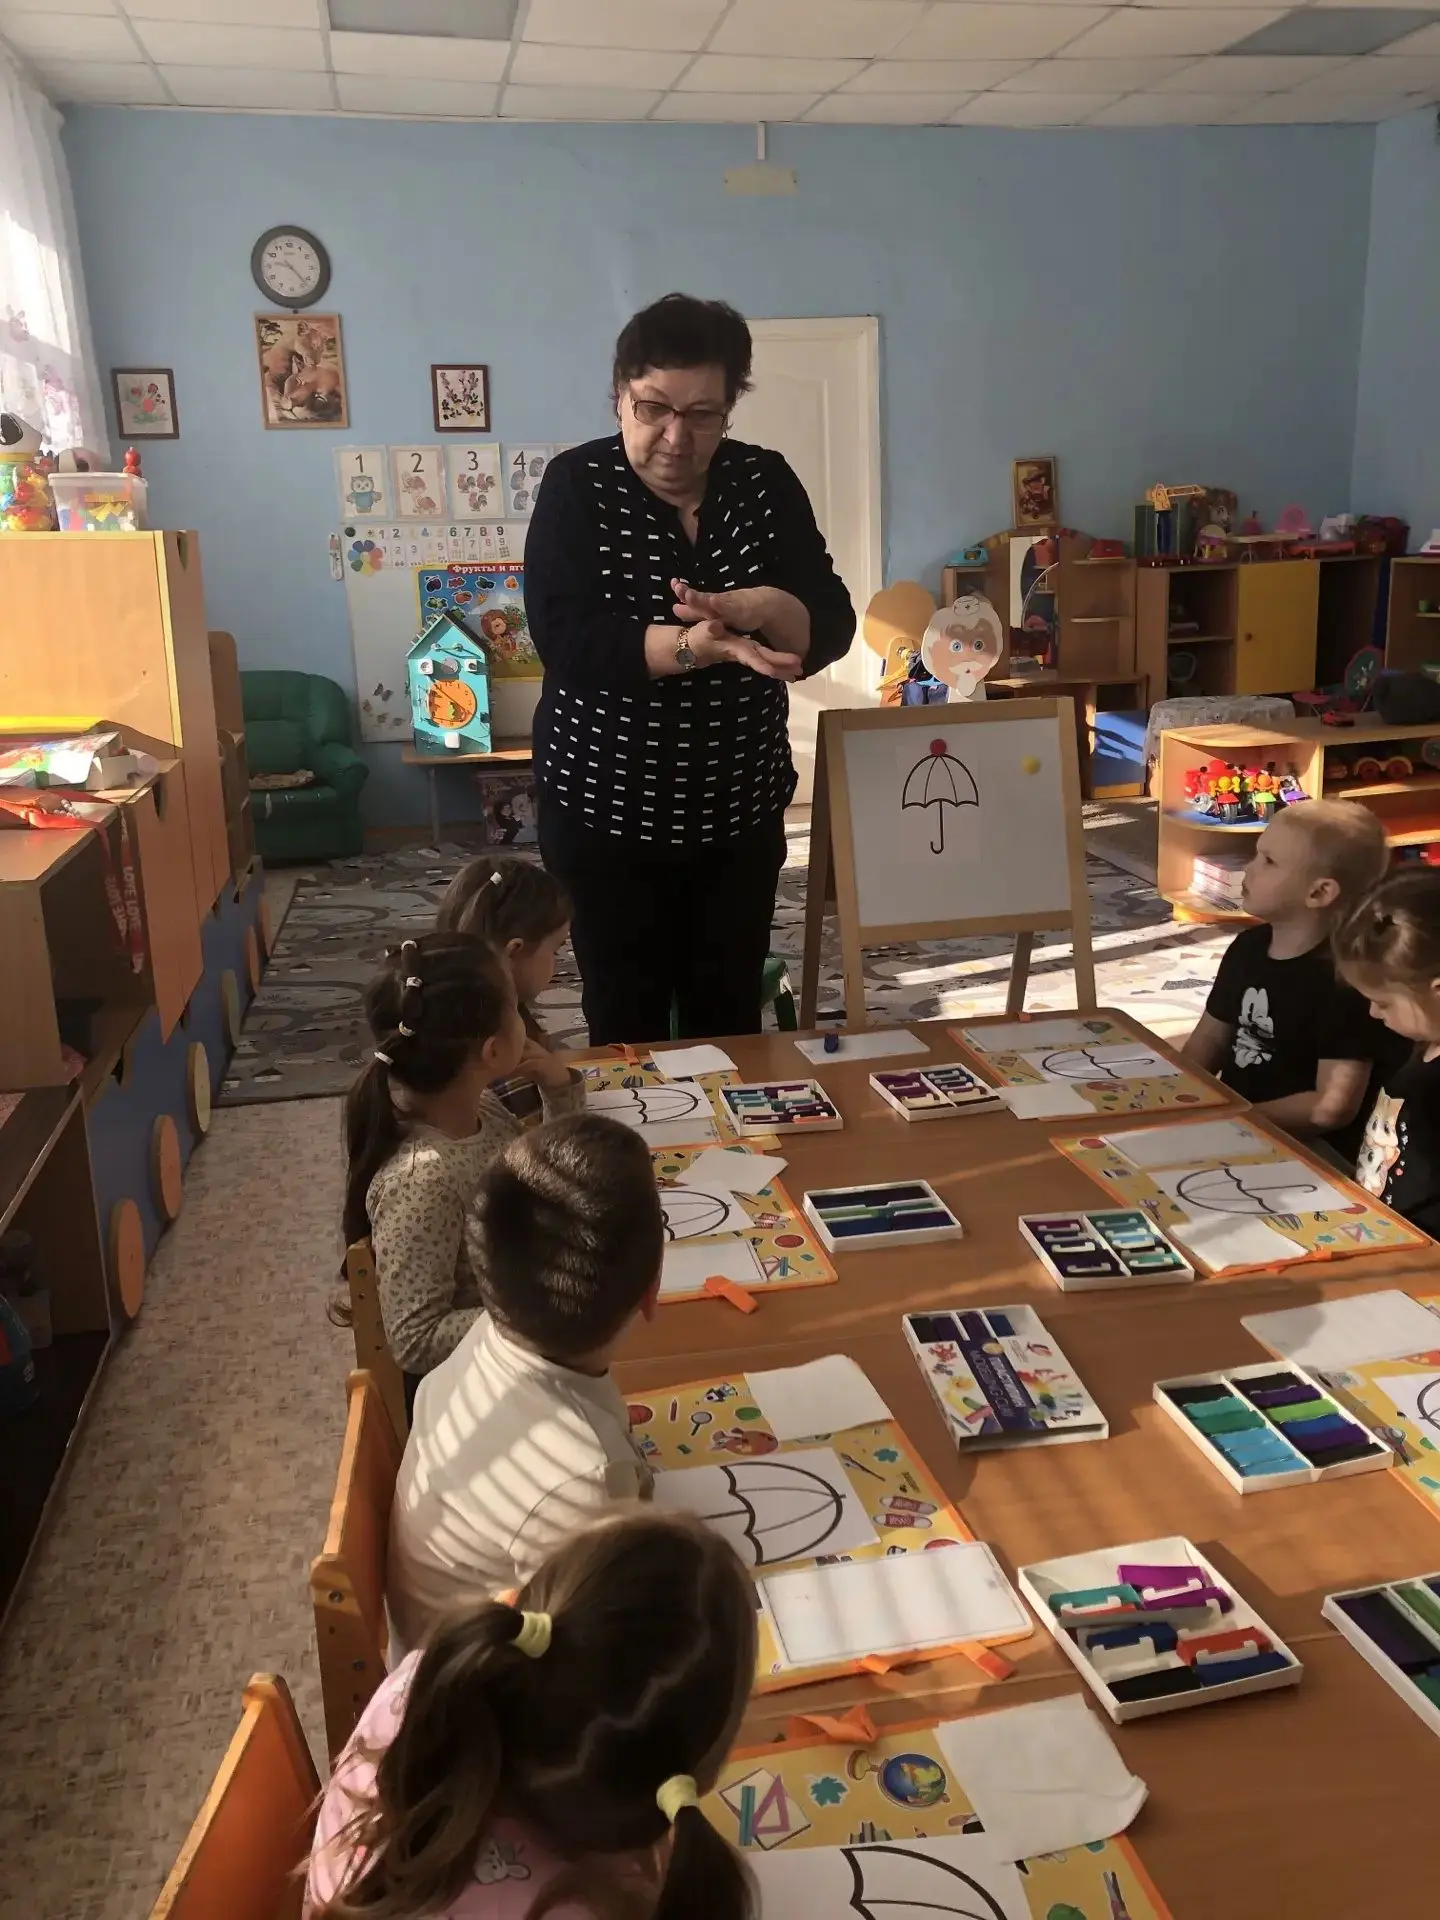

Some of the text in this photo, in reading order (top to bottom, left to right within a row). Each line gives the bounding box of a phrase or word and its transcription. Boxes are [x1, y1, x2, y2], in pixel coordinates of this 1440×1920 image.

[355, 453, 364, 473] 1
[411, 452, 424, 473] 2
[467, 450, 479, 471] 3
[513, 450, 527, 471] 4
[392, 528, 400, 538] 2
[449, 527, 457, 537] 6
[464, 527, 471, 537] 7
[480, 526, 487, 537] 8
[496, 526, 504, 536] 9
[411, 545, 417, 553] 3
[438, 542, 444, 551] 5
[470, 540, 475, 548] 7
[452, 564, 496, 574] Фрукты
[499, 564, 505, 572] и
[122, 866, 142, 928] LOVE LOVE
